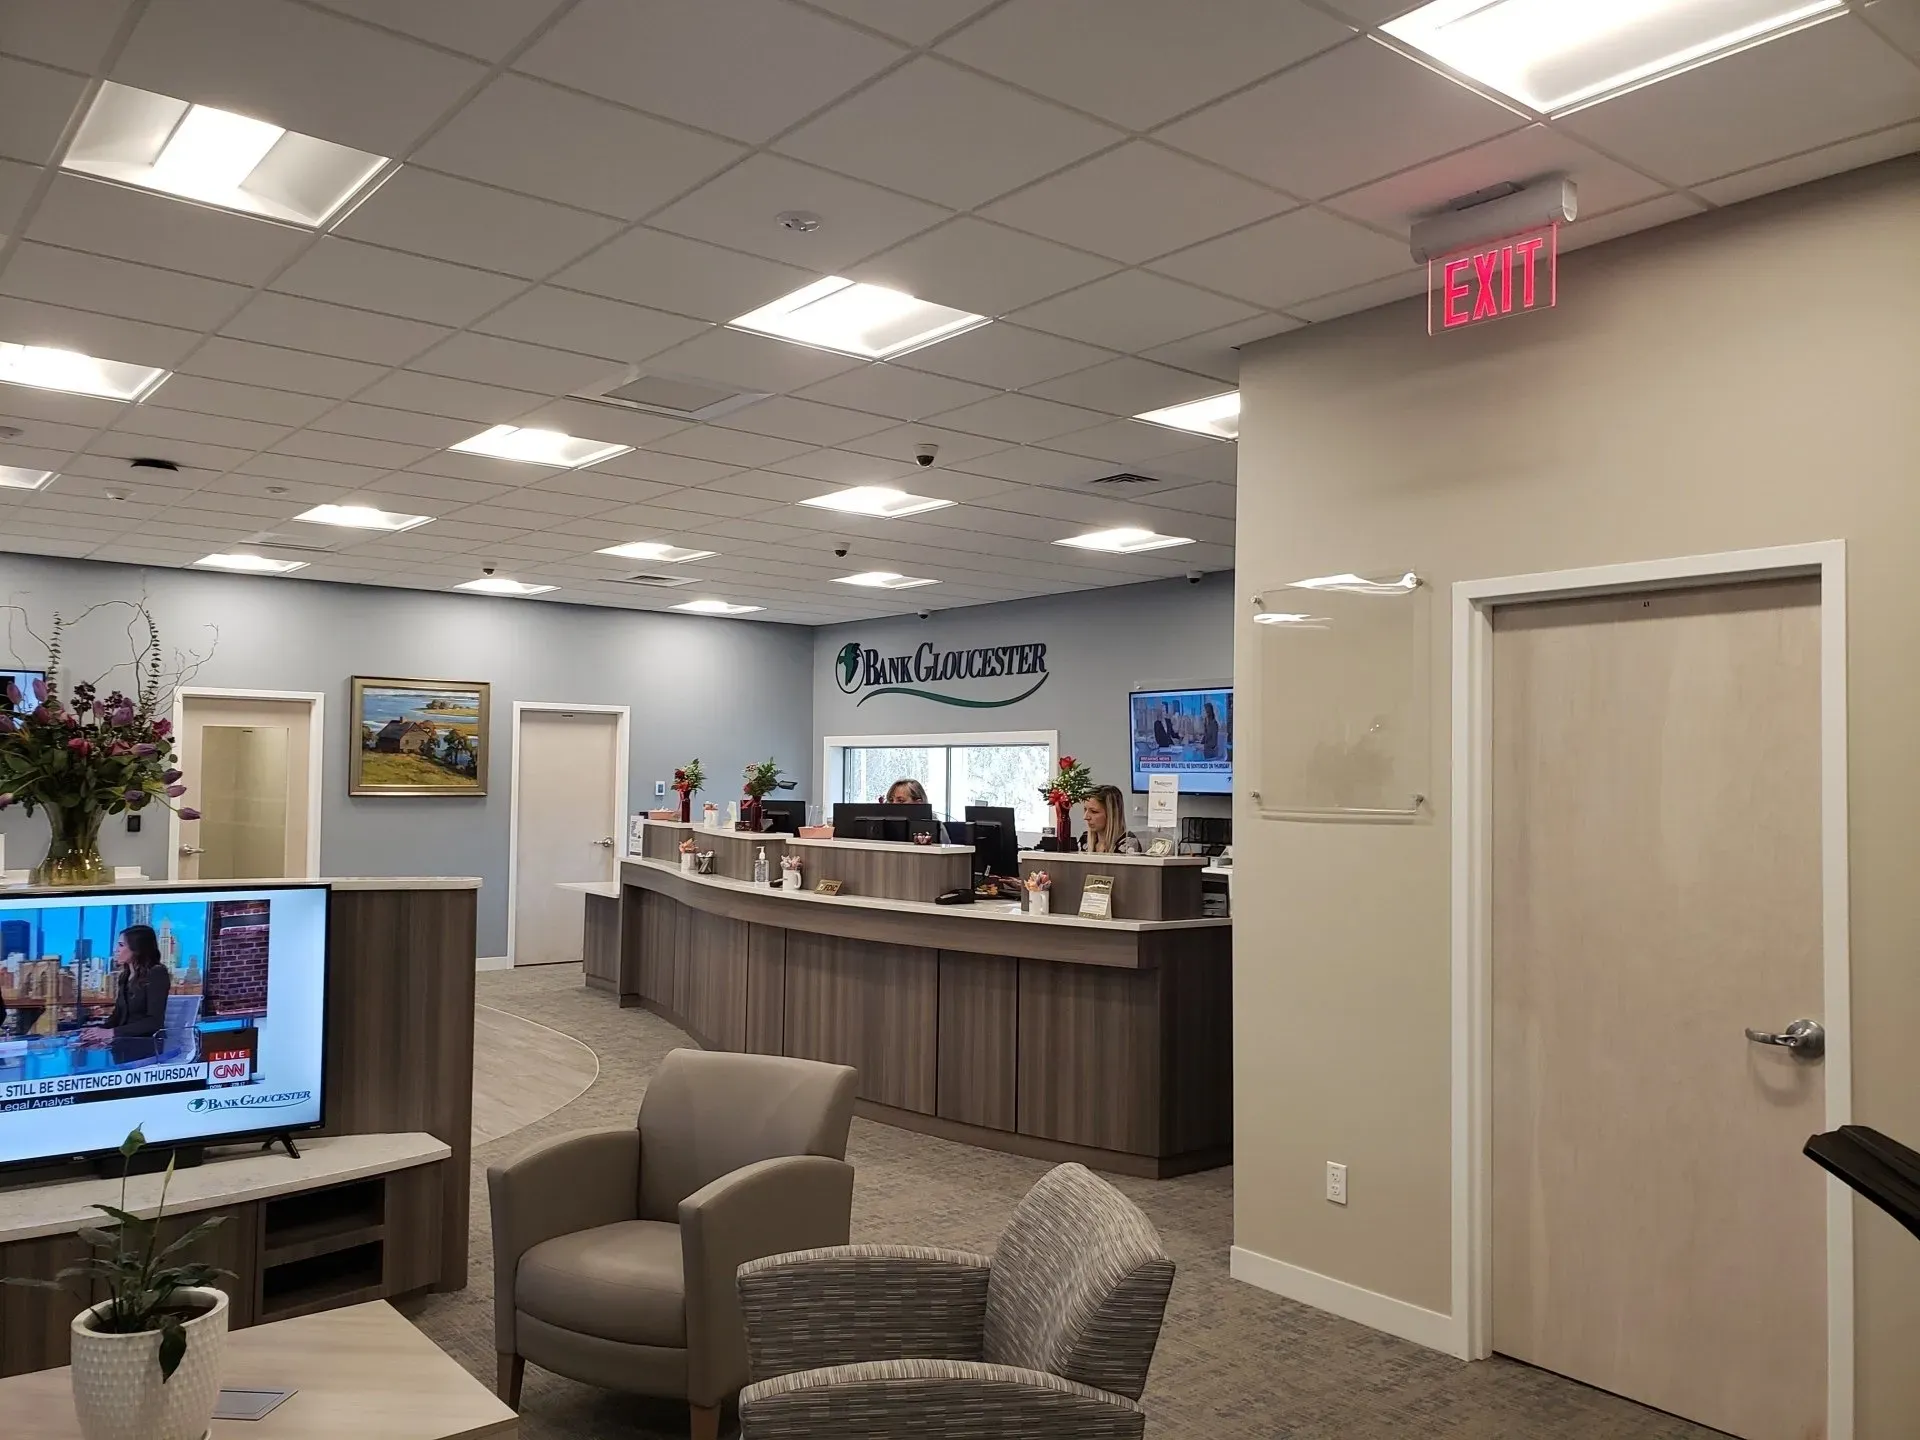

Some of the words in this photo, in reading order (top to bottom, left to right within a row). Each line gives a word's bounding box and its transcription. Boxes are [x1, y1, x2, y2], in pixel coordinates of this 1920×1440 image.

[1444, 237, 1543, 327] EXIT
[863, 649, 914, 686] BANK
[914, 642, 1047, 682] GLOUCESTER
[215, 1050, 246, 1060] LIVE
[213, 1063, 245, 1079] CNN
[6, 1083, 36, 1097] STILL
[40, 1081, 54, 1094] BE
[57, 1075, 122, 1092] SENTENCED
[125, 1072, 141, 1084] ON
[143, 1066, 200, 1083] THURSDAY
[0, 1100, 30, 1112] Legal
[32, 1095, 75, 1109] Analyst
[207, 1098, 239, 1110] BANK
[240, 1090, 311, 1106] GLOUCESTER
